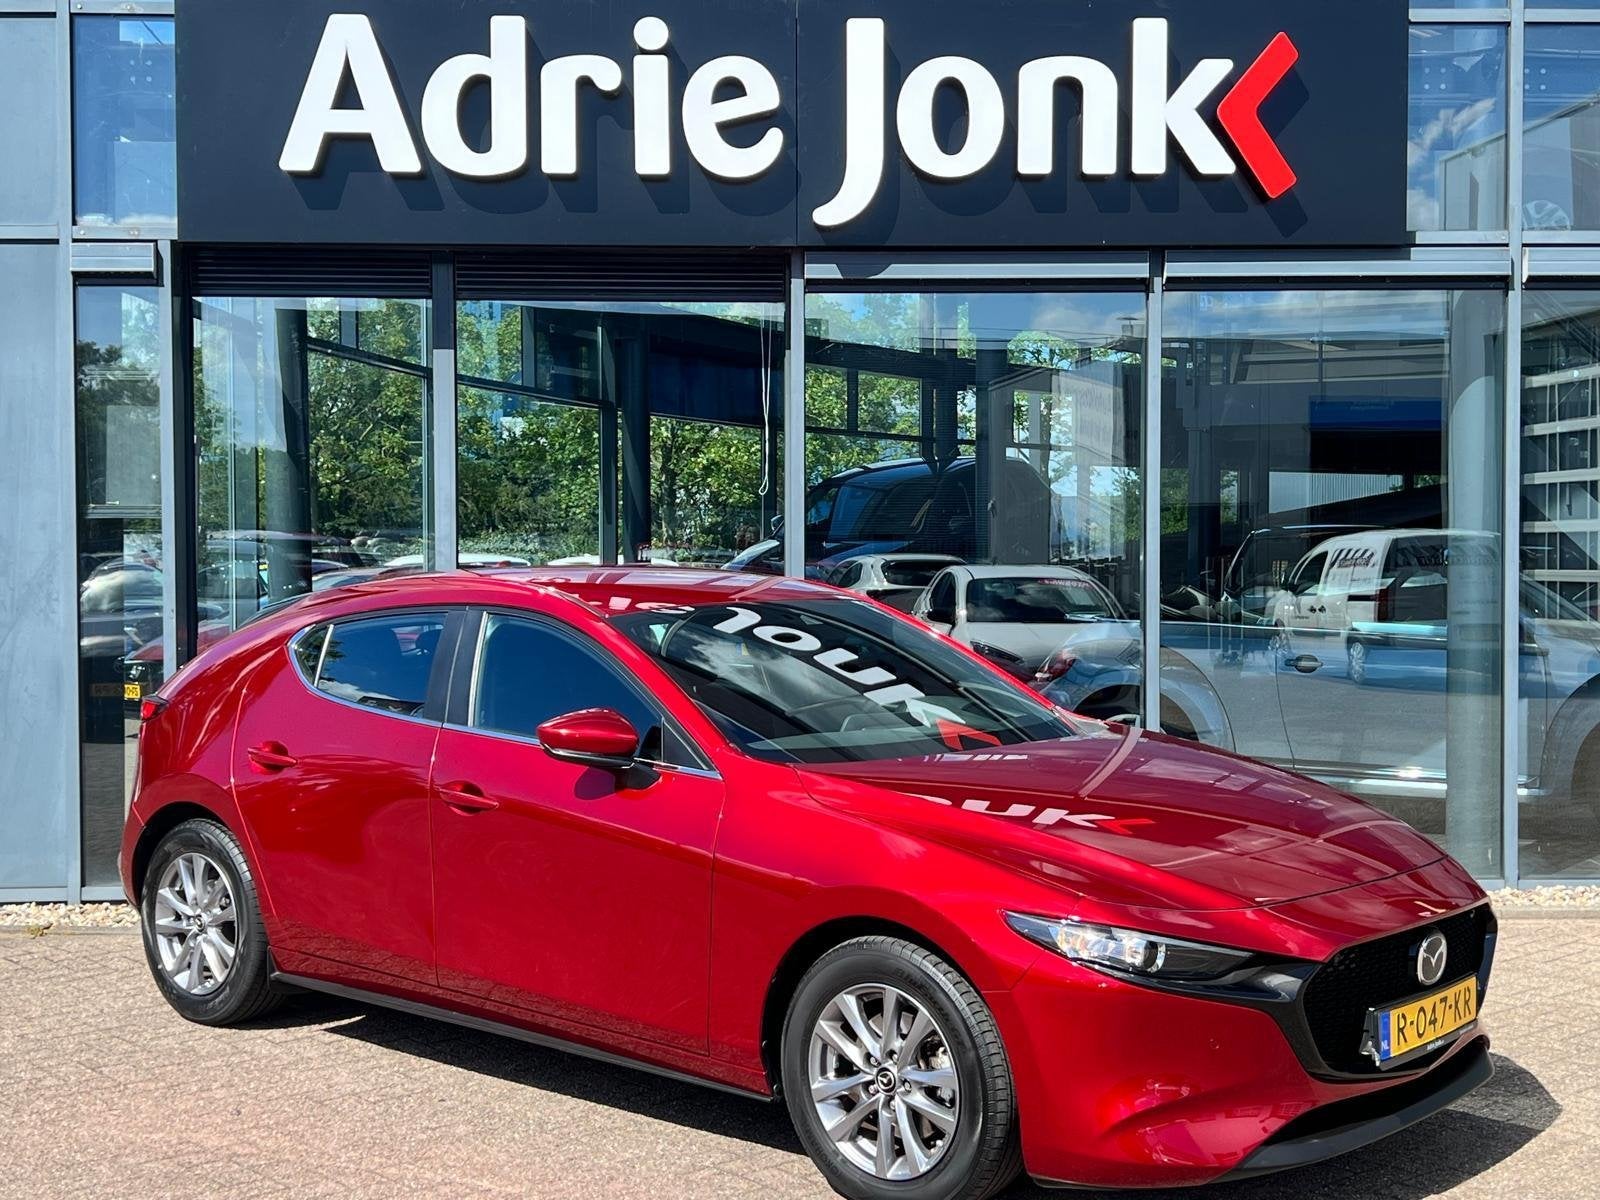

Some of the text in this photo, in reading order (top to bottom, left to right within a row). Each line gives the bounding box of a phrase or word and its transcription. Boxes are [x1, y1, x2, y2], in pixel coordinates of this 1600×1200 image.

[278, 14, 1235, 228] Adrie Jonk
[1381, 1041, 1390, 1051] NL
[1397, 986, 1471, 1046] R-047-KR
